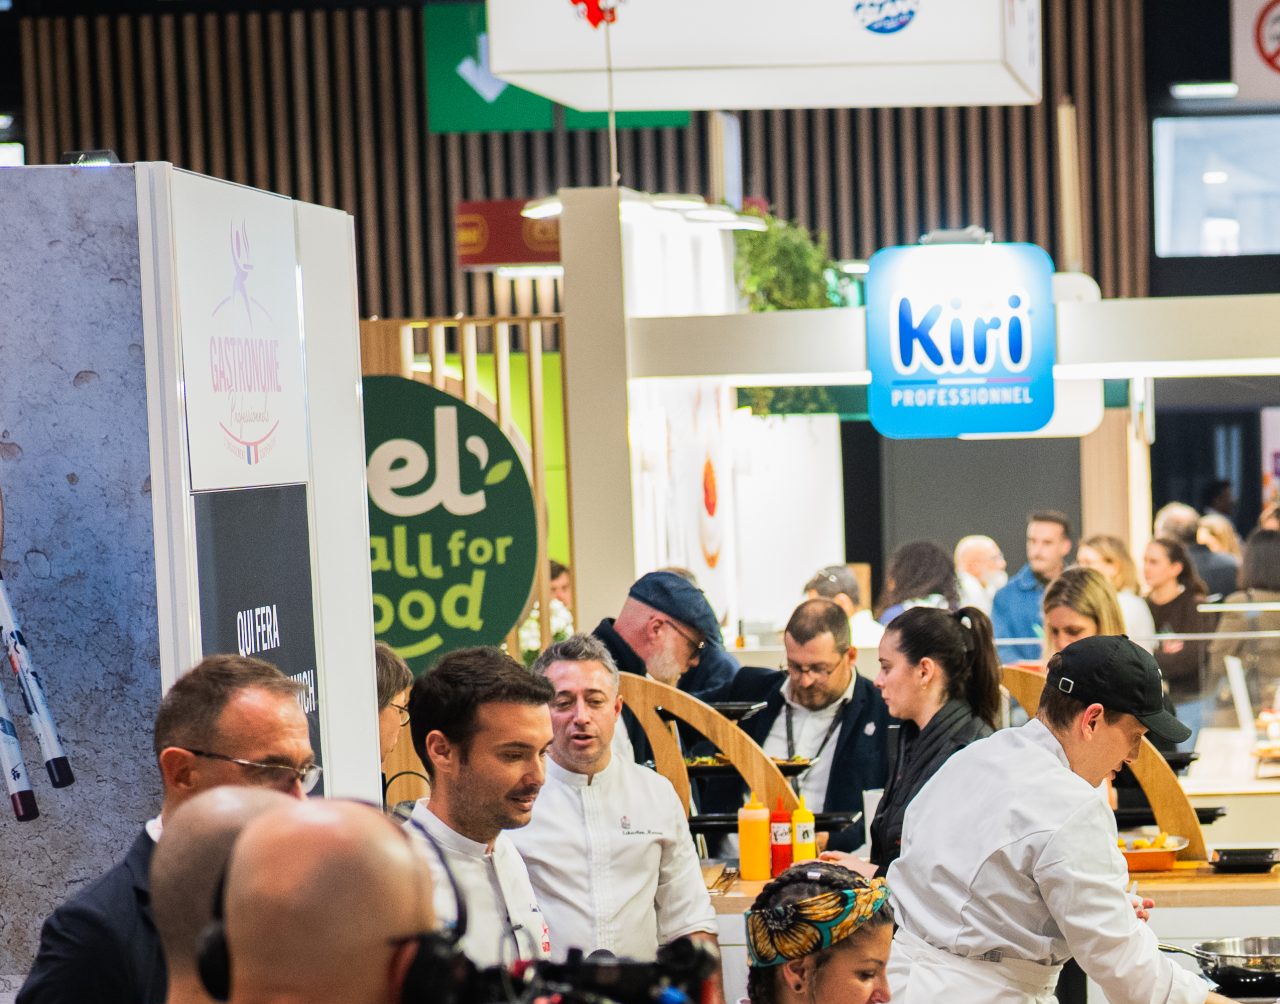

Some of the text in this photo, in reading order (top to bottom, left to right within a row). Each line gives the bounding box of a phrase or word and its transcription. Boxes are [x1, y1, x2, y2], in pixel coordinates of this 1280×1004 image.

[209, 335, 282, 392] GASTRONOME
[891, 386, 1034, 407] PROFESSIONNEL
[447, 529, 514, 568] for
[372, 569, 486, 635] ood
[236, 604, 281, 659] QUI FERA
